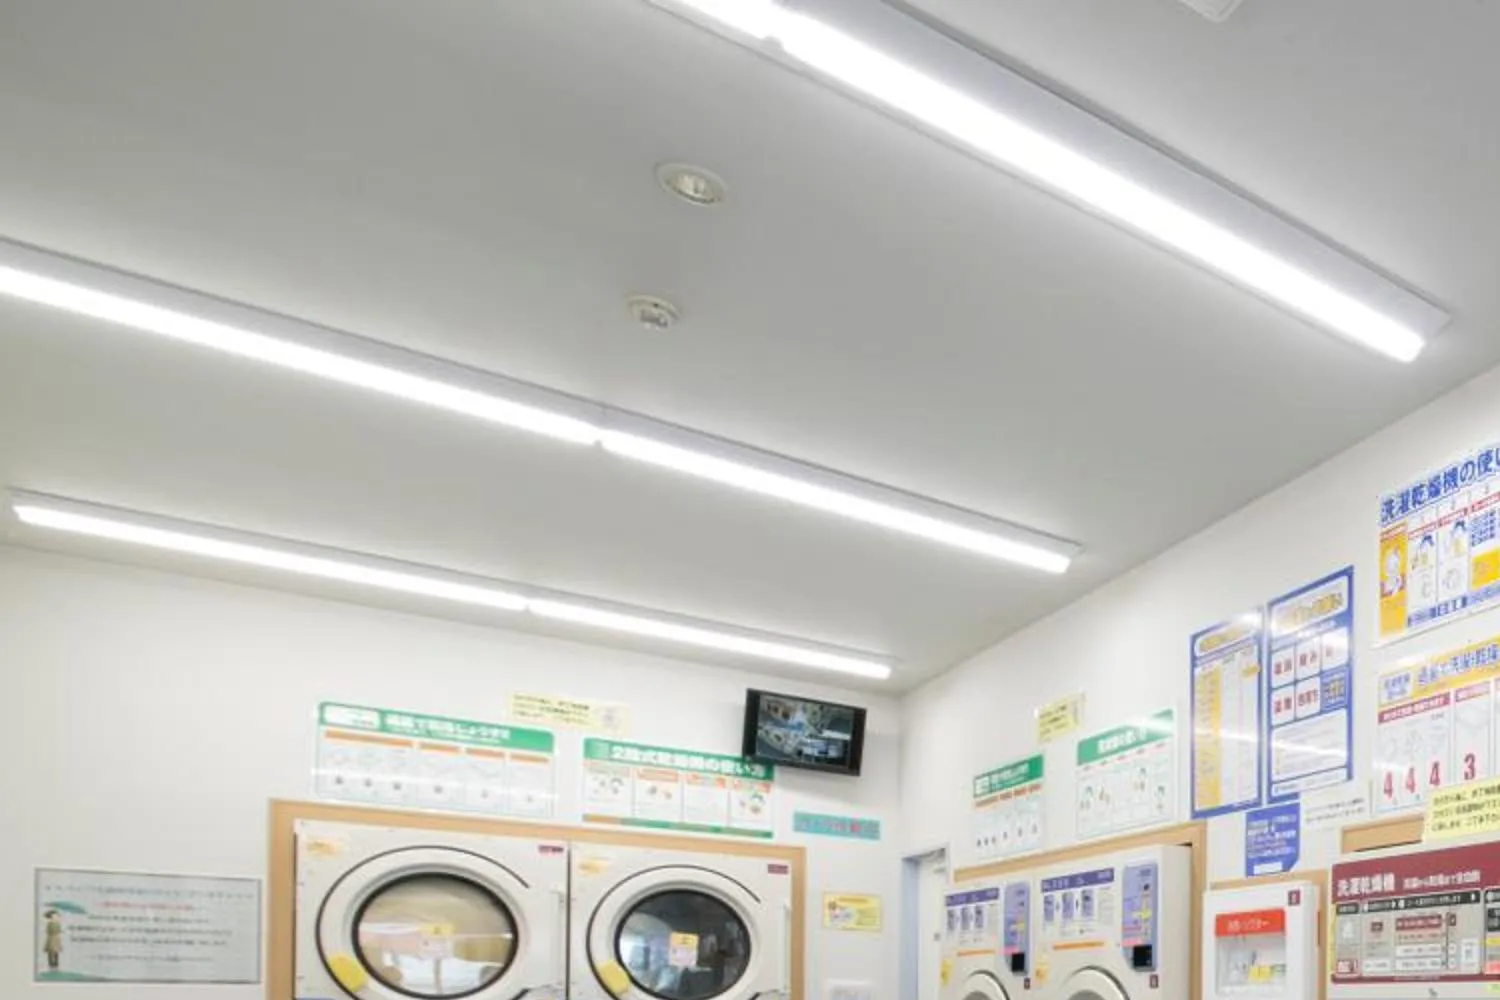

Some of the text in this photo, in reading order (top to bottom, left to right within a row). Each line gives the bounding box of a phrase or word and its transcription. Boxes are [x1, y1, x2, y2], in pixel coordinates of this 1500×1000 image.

[1405, 766, 1416, 794] 4
[1429, 760, 1441, 788] 4
[1464, 753, 1476, 781] 3
[1383, 771, 1394, 799] 4
[1337, 872, 1396, 897] 洗濯乾燥機
